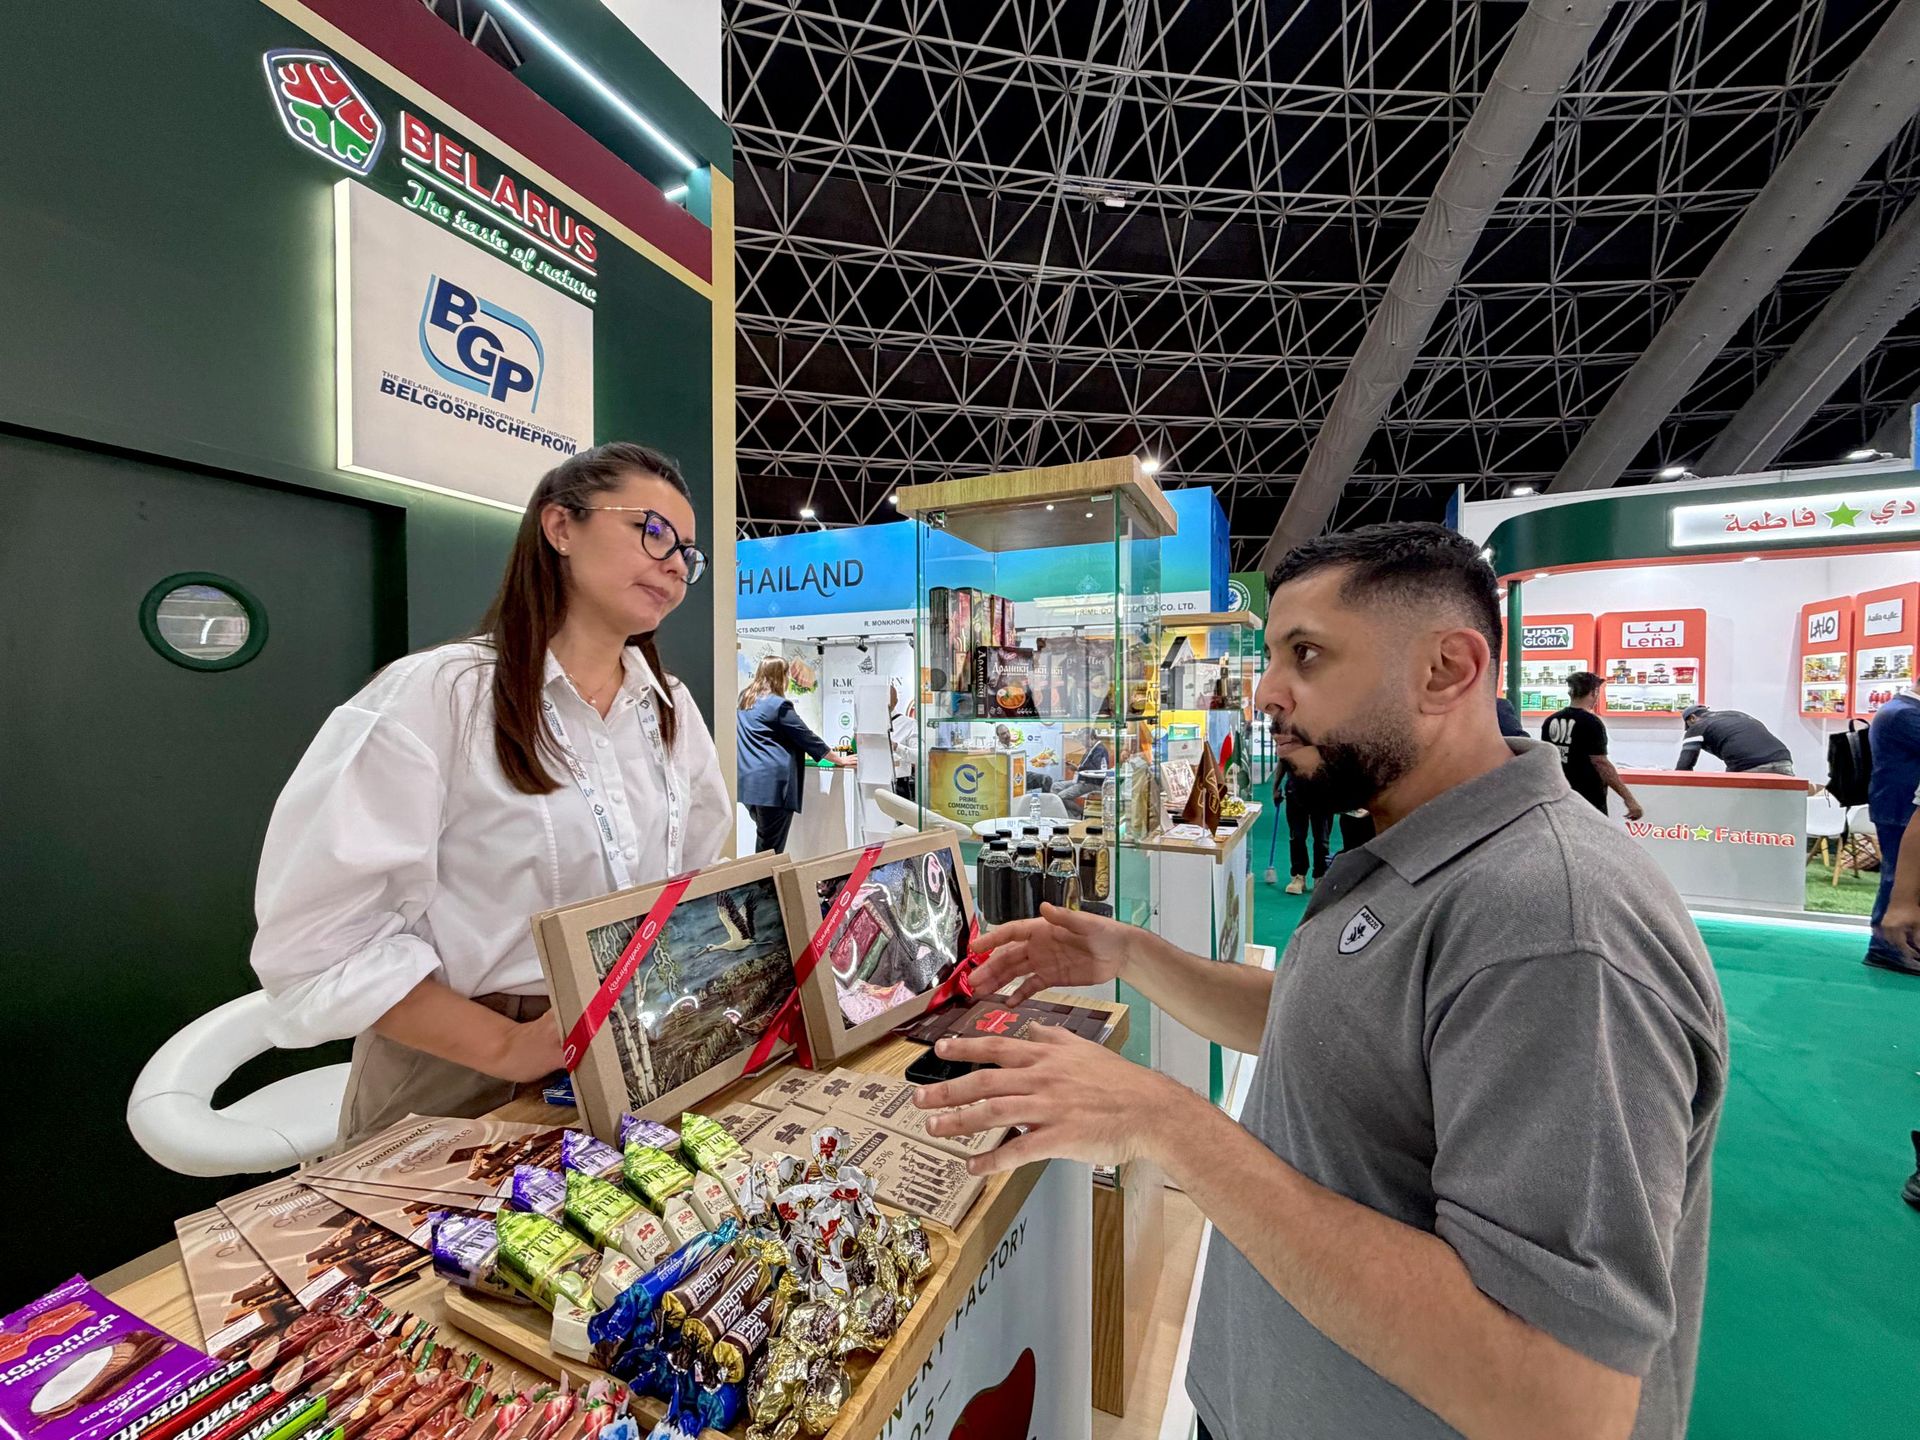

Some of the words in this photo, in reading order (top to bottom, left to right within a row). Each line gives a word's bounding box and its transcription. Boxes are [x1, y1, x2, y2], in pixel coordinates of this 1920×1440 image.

[401, 110, 598, 263] BELARUS
[403, 179, 451, 222] The
[452, 210, 510, 254] taste
[511, 247, 537, 272] of
[536, 260, 598, 303] nature
[428, 278, 534, 402] BGP
[380, 377, 577, 456] BELGOSPISCHEPROM
[382, 370, 400, 381] THE
[402, 377, 453, 400] BELARUSIAN
[455, 396, 478, 409] STATE
[480, 405, 514, 422] CONCERN
[516, 418, 526, 426] OF
[527, 421, 546, 433] FOOD
[547, 429, 578, 443] INDUSTRY
[1723, 506, 1818, 533] فاطمة
[1869, 499, 1918, 525] دي
[736, 559, 864, 598] HAILAND
[1160, 603, 1175, 612] CO.
[1178, 602, 1196, 611] LTD.
[749, 624, 776, 634] INDUSTRY
[871, 618, 910, 627] MONKHORN
[1523, 635, 1567, 647] GLORIA
[948, 802, 989, 811] COMMODITIES
[958, 795, 978, 803] PRIME
[1625, 821, 1690, 841] Wadi
[1714, 826, 1797, 848] Fatma
[865, 1080, 908, 1117] ШОКОЛАД
[885, 1085, 917, 1116] МОЛОЧНЫ
[732, 1110, 774, 1140] ОКОЛАД
[848, 1125, 878, 1151] ОЛАД
[872, 1148, 895, 1167] 55%
[530, 1178, 567, 1206] Пущ
[693, 1255, 736, 1298] PROTEIN
[954, 1216, 1029, 1332] FACTORY
[716, 1269, 759, 1320] PROTEIN
[723, 1300, 745, 1330] 22%
[736, 1296, 774, 1335] PROTEIN
[745, 1318, 767, 1344] 22%
[5, 1323, 114, 1386] МОЛОЧНЫЙ
[79, 1370, 164, 1425] КОКОСОВАЯ
[108, 1358, 249, 1440] арядись
